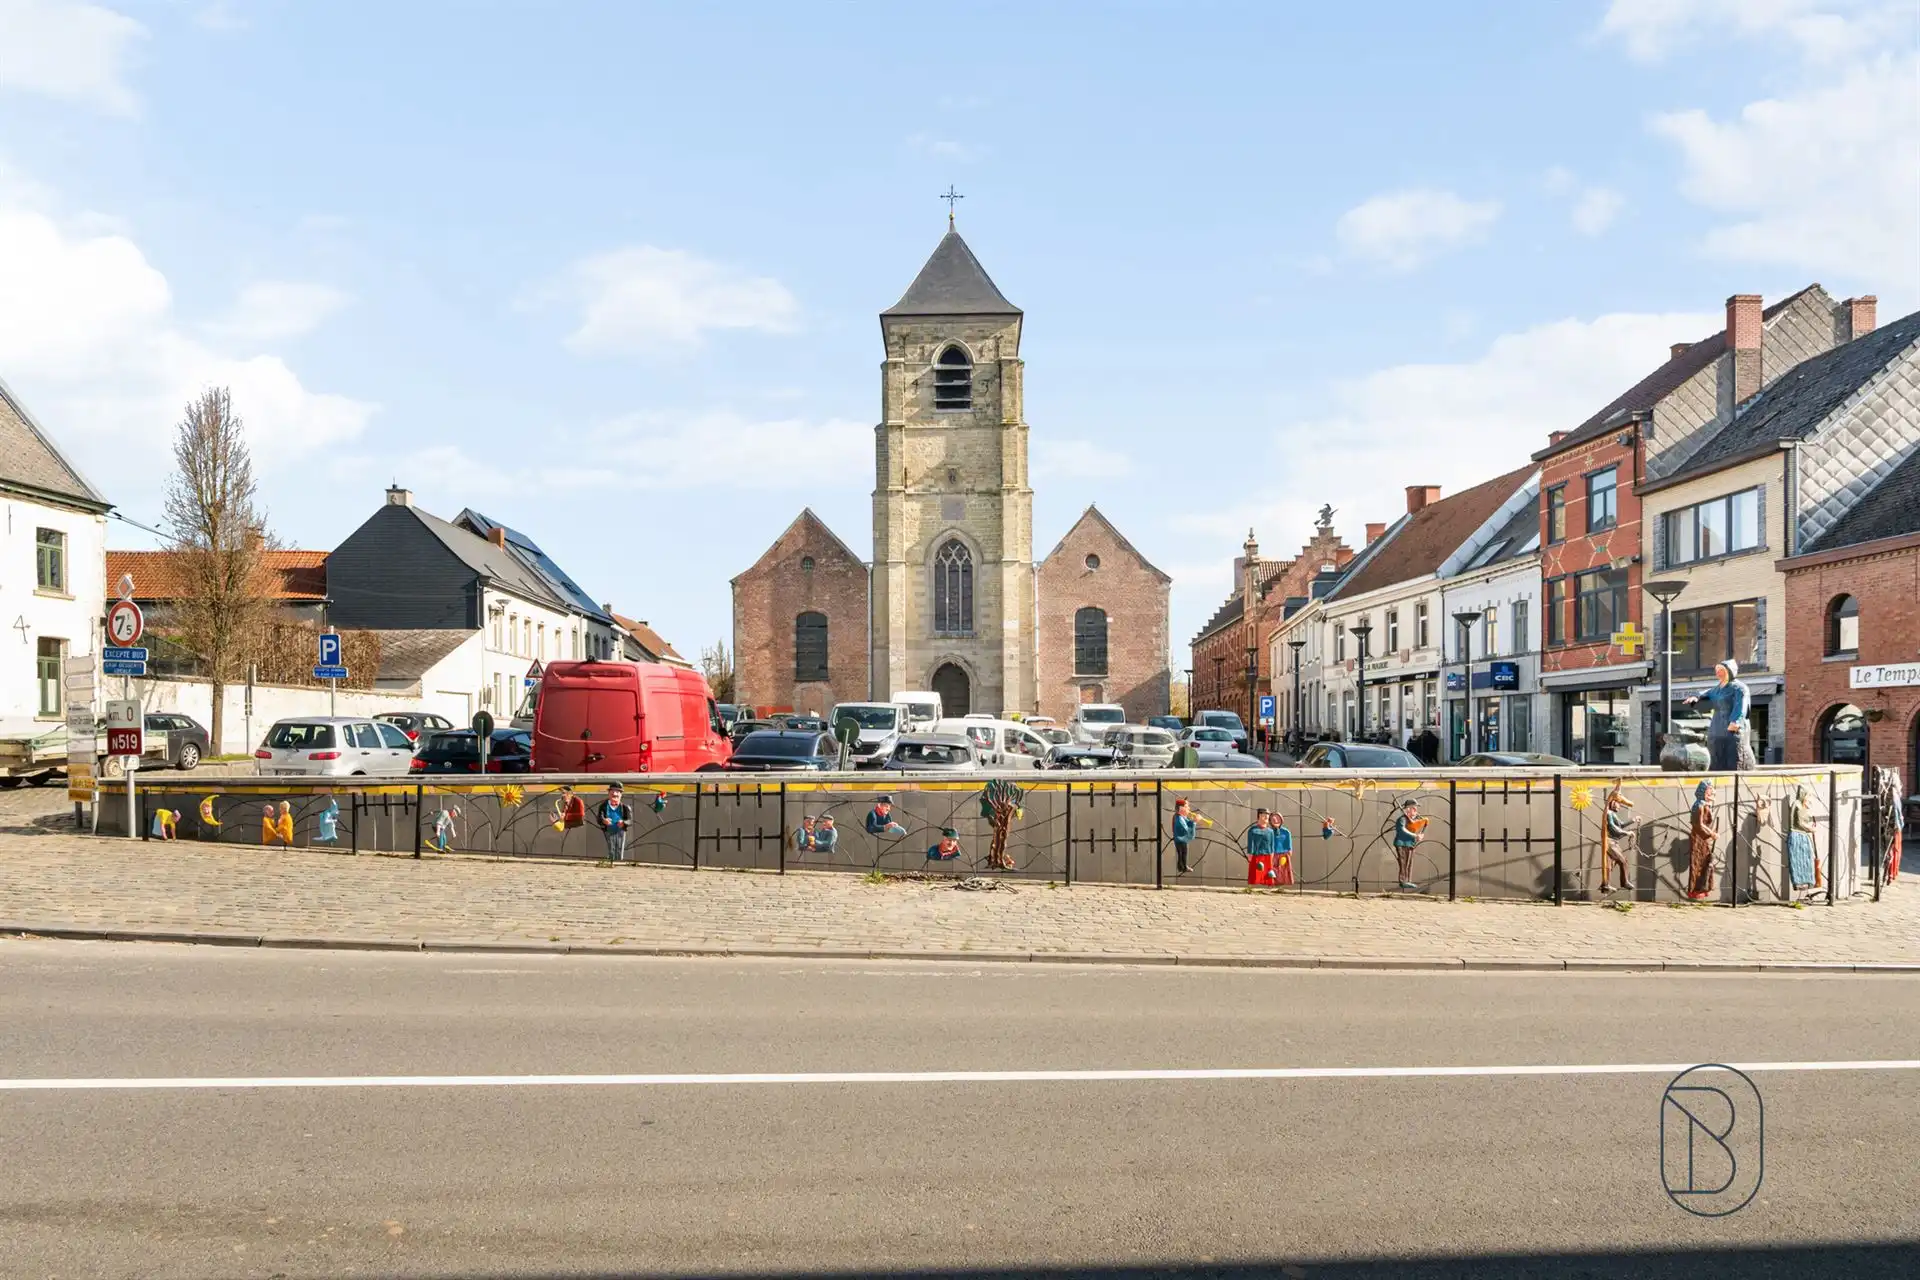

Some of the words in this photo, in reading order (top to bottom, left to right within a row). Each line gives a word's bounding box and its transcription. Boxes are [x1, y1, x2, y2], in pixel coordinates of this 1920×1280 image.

[132, 651, 144, 659] BUS
[322, 639, 337, 661] P
[1856, 669, 1872, 683] Le
[1262, 699, 1273, 714] P
[112, 734, 138, 749] N519
